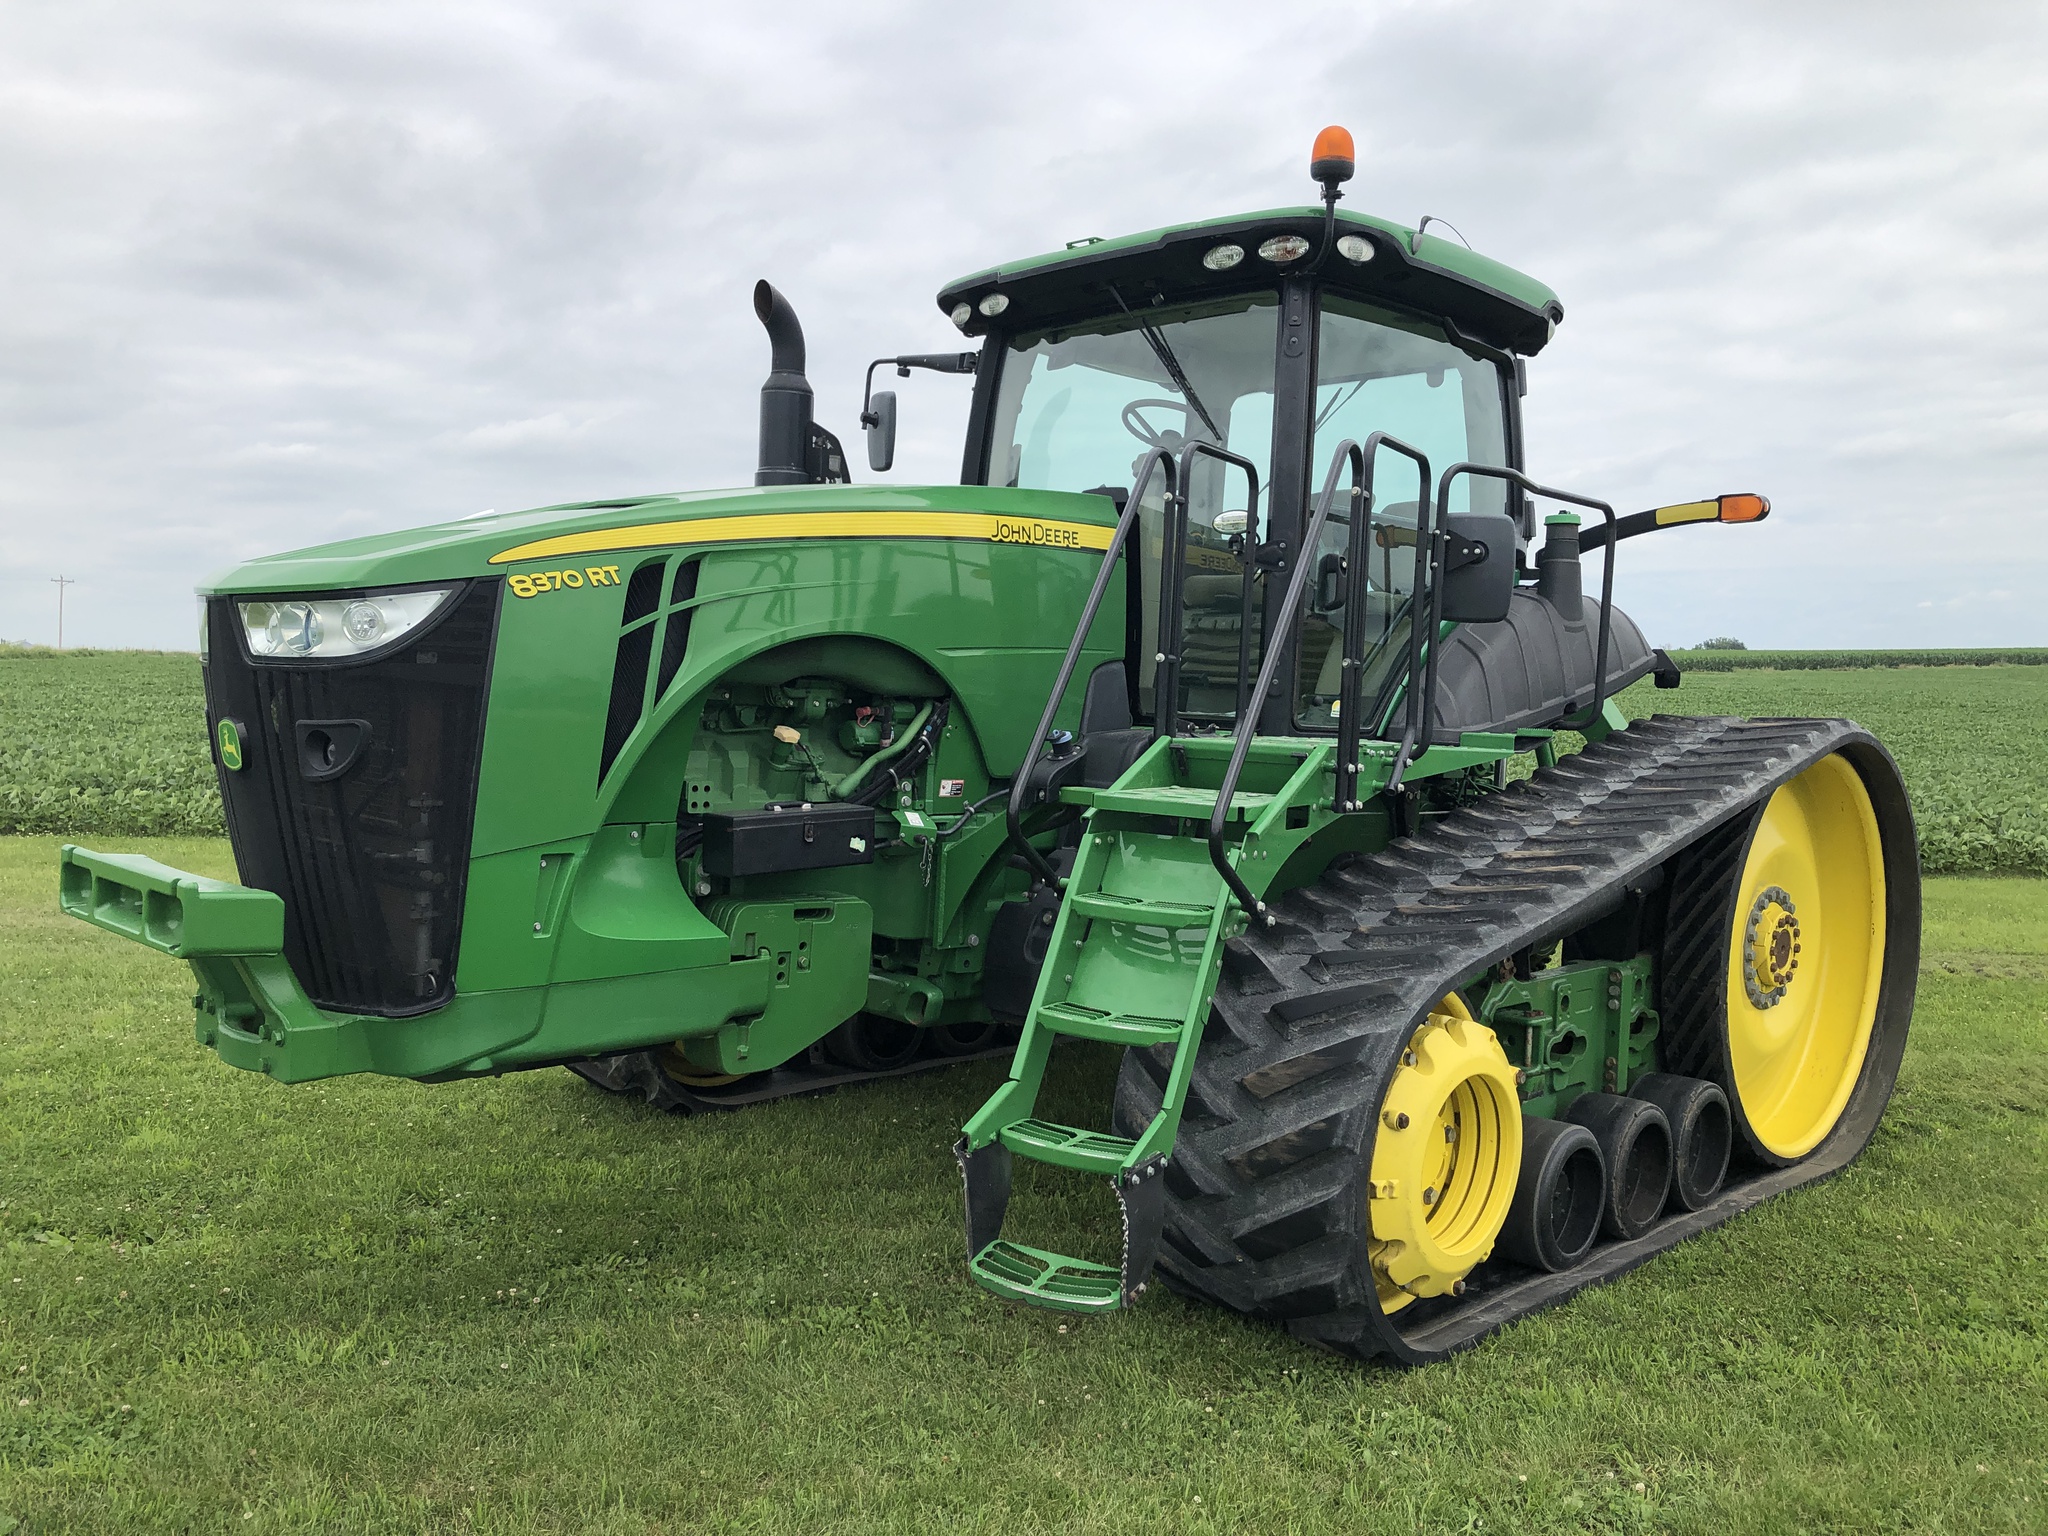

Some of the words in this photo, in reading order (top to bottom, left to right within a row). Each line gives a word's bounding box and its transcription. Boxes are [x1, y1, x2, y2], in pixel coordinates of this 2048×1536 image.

[991, 519, 1032, 541] JOHN
[1033, 523, 1080, 546] DEERE
[508, 569, 584, 598] 8370
[584, 565, 621, 587] RT
